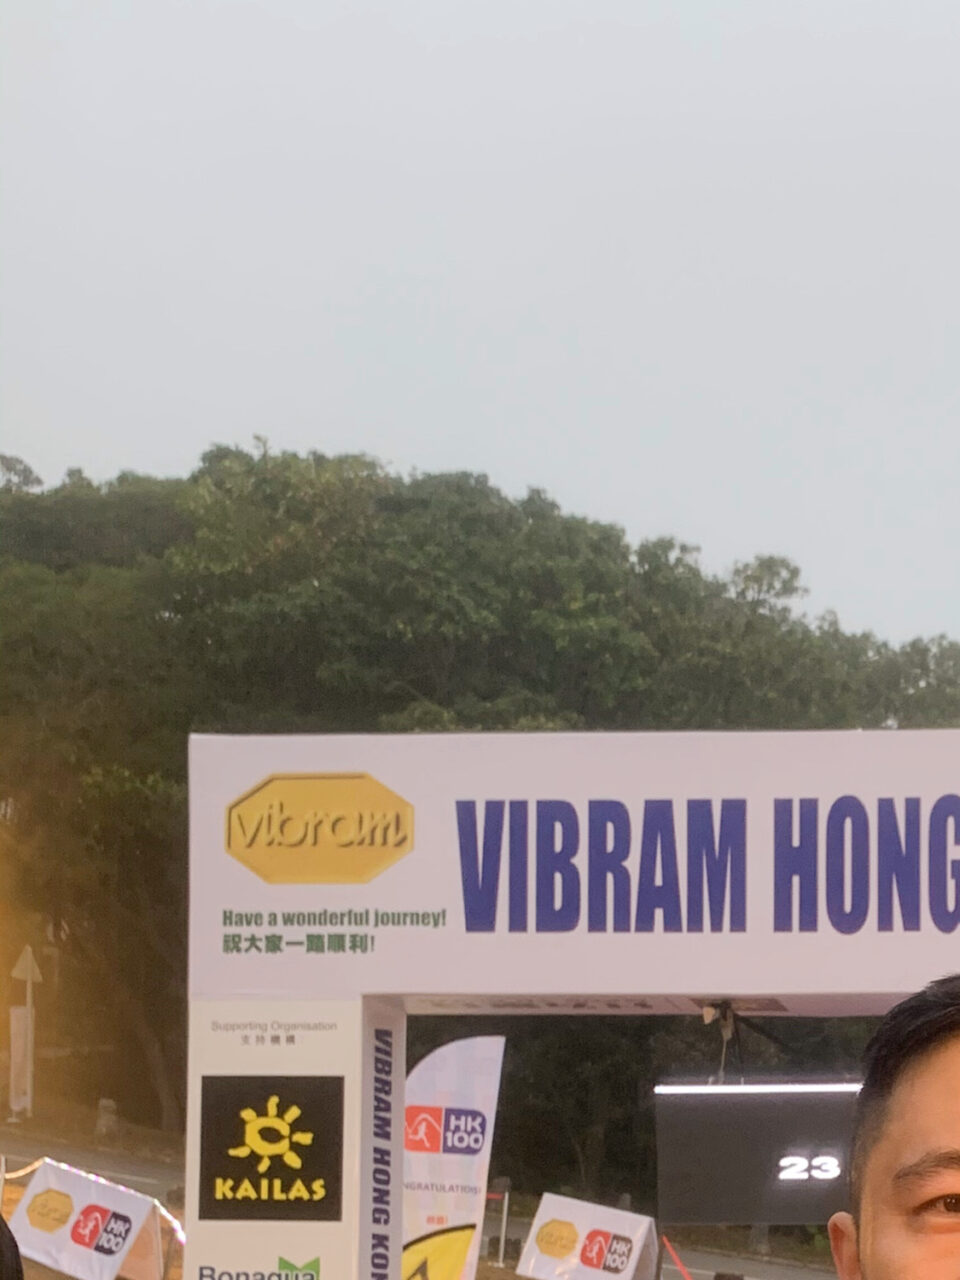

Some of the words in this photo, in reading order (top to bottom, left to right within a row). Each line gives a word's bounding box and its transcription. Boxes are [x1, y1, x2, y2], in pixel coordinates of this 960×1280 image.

[234, 800, 408, 850] vibram
[455, 797, 747, 933] VIBRAM
[222, 909, 264, 927] Have
[267, 912, 278, 927] a
[282, 908, 370, 927] wonderful
[373, 908, 447, 929] journey!
[222, 933, 375, 954] 祝大家一路順利!
[211, 1020, 268, 1034] Supporting
[270, 1020, 338, 1034] Organisation
[372, 1027, 394, 1142] VIBRAM
[449, 1114, 483, 1132] HK
[445, 1132, 484, 1150] 100
[777, 1155, 841, 1181] 23
[214, 1177, 327, 1201] KAILAS
[371, 1147, 393, 1227] HONG
[106, 1218, 130, 1236] HK
[99, 1233, 123, 1251] 100
[610, 1239, 631, 1256] HK
[606, 1253, 628, 1271] 100
